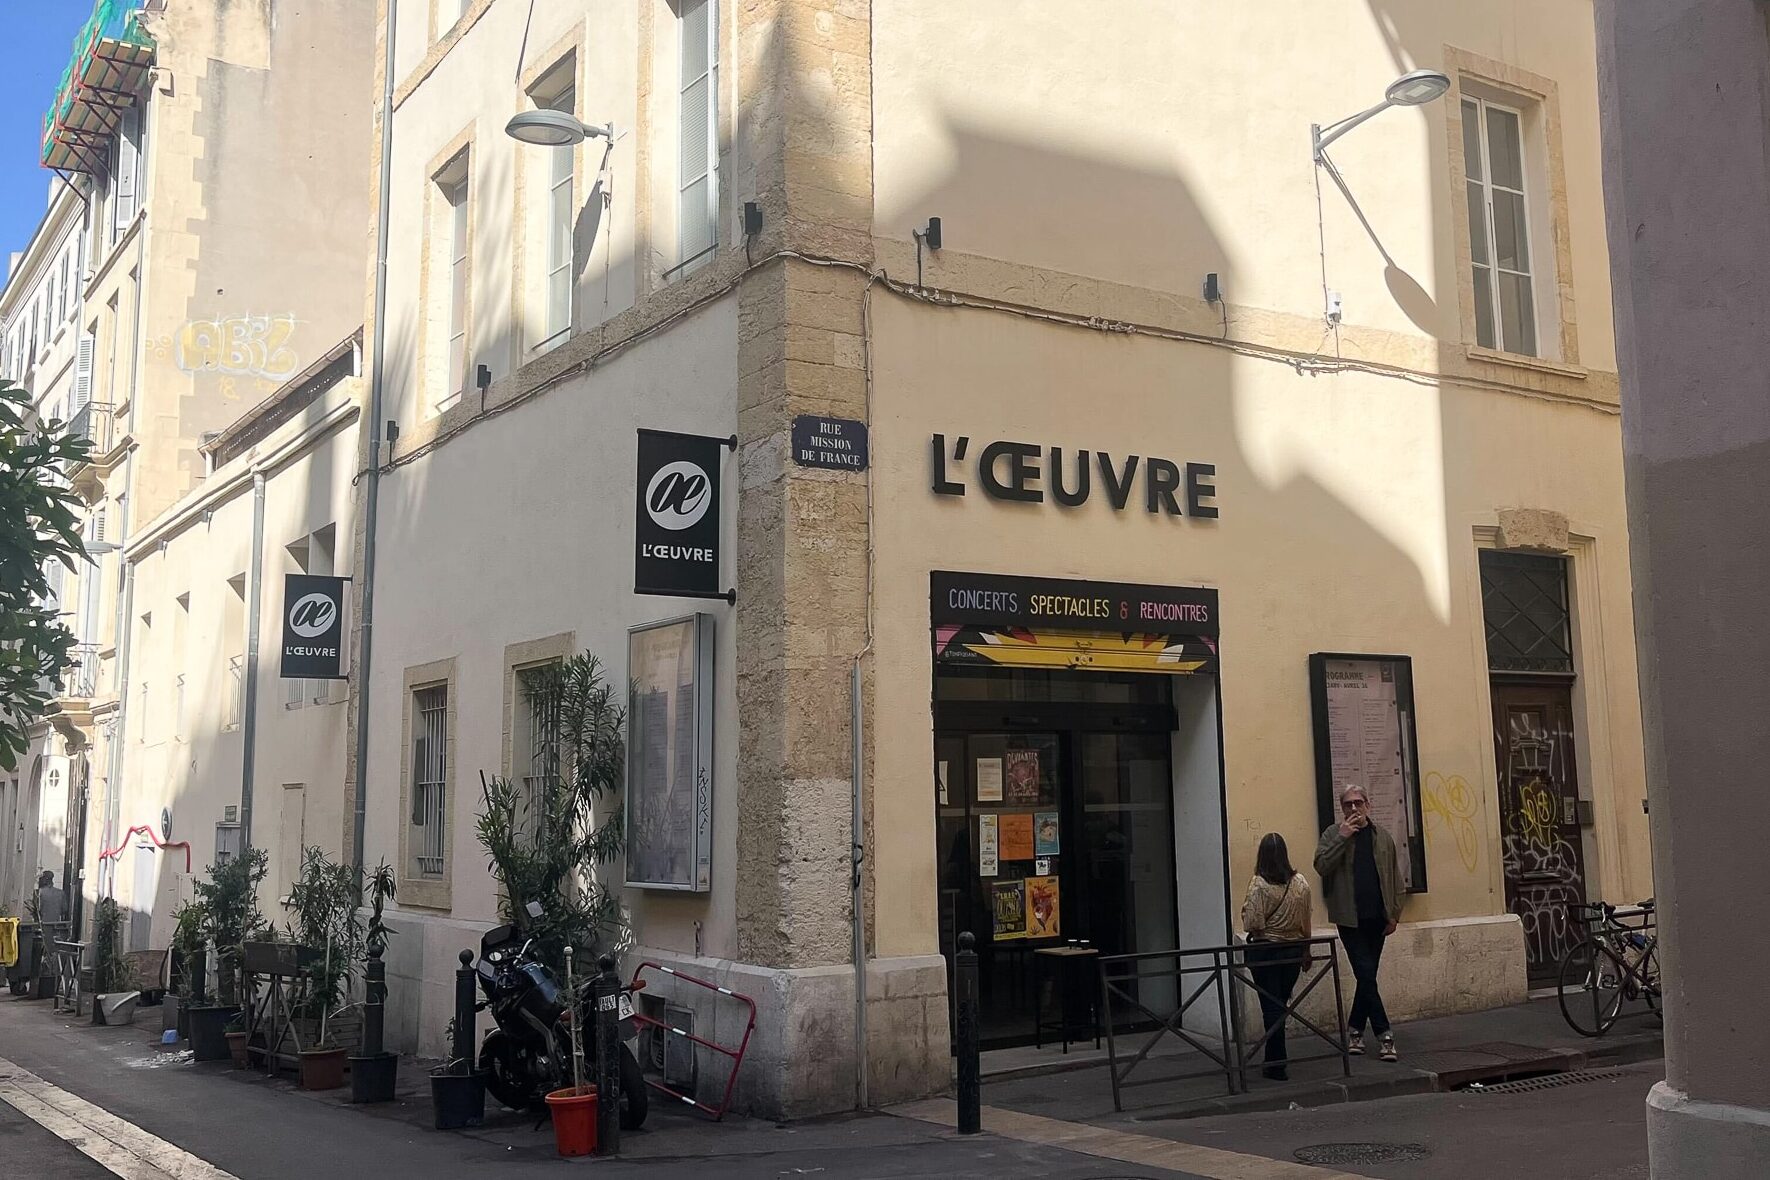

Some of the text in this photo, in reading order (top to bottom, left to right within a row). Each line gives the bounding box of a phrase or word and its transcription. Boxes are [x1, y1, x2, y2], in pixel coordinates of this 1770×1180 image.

[820, 422, 842, 436] RUE
[810, 436, 852, 451] MISSION
[801, 449, 860, 466] DE FRANCE
[1030, 595, 1110, 618] SPECTACLES
[1140, 602, 1208, 622] RENCONTRES
